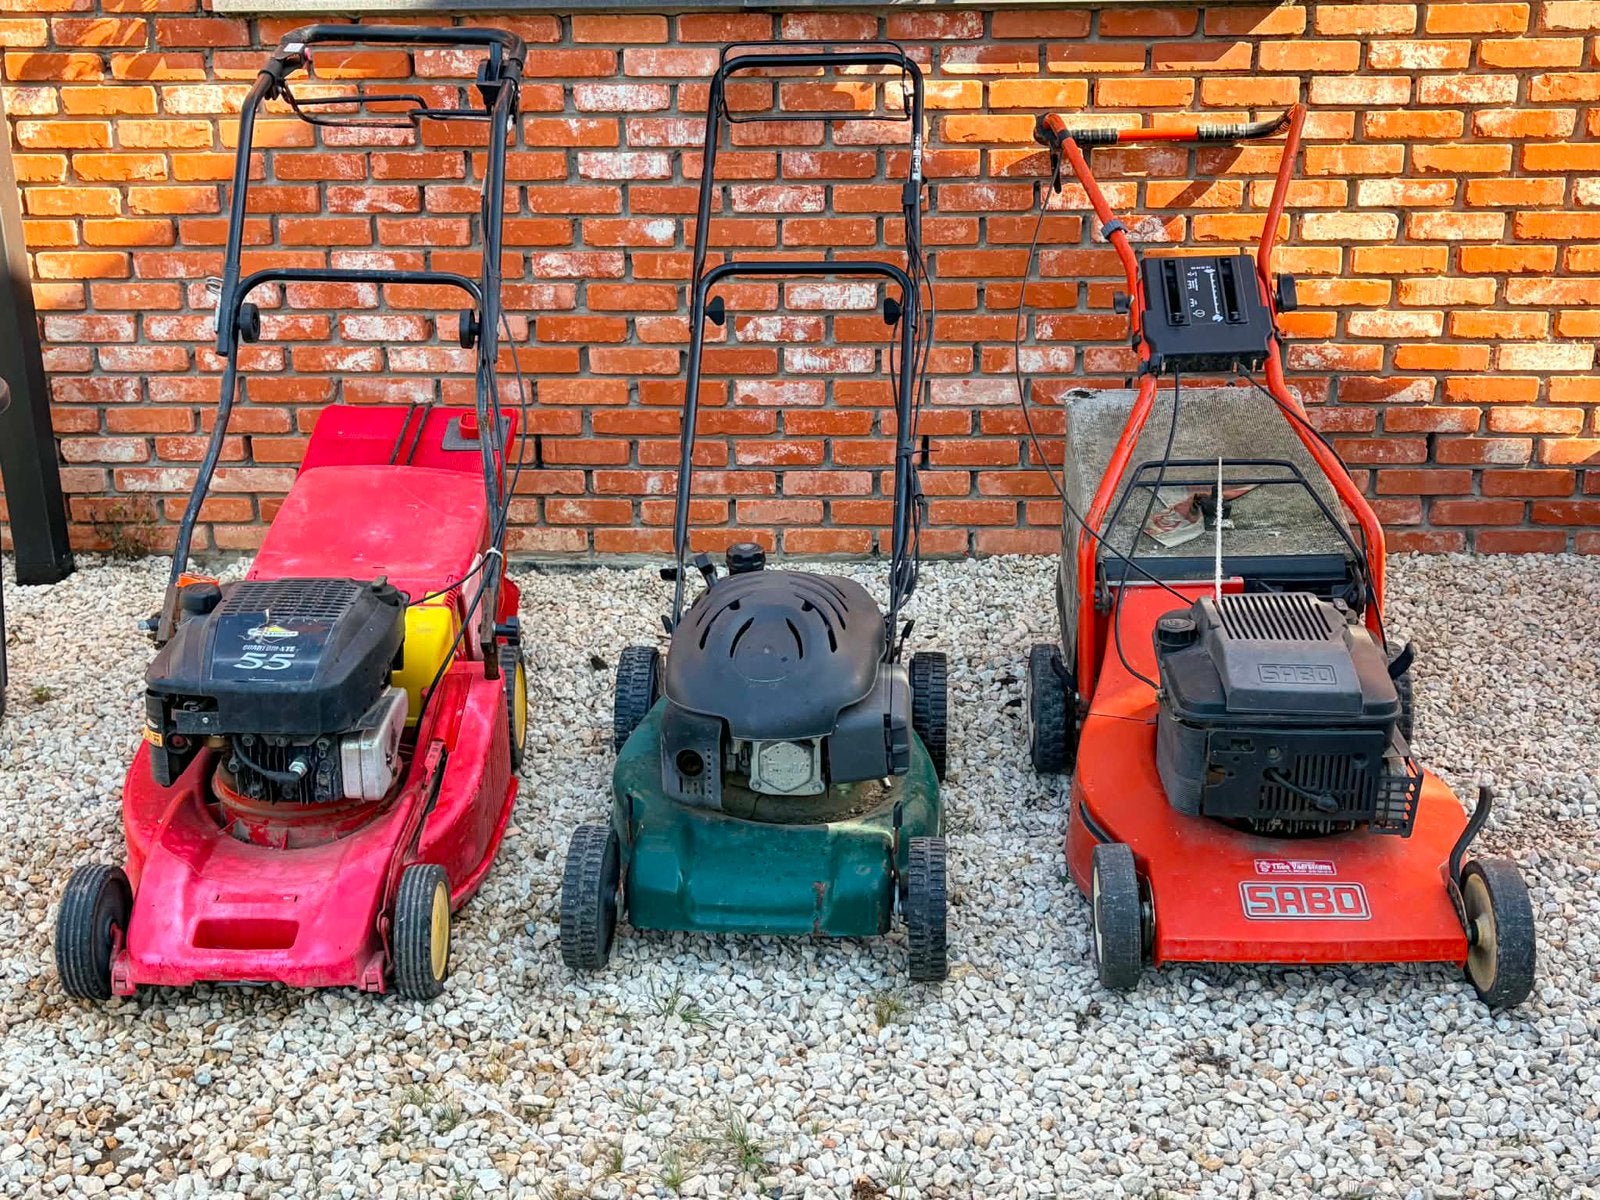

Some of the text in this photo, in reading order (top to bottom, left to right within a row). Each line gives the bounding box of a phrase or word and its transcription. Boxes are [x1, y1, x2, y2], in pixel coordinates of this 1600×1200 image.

[233, 652, 295, 670] 55
[1261, 665, 1333, 682] SABO
[1246, 886, 1363, 914] SABO
